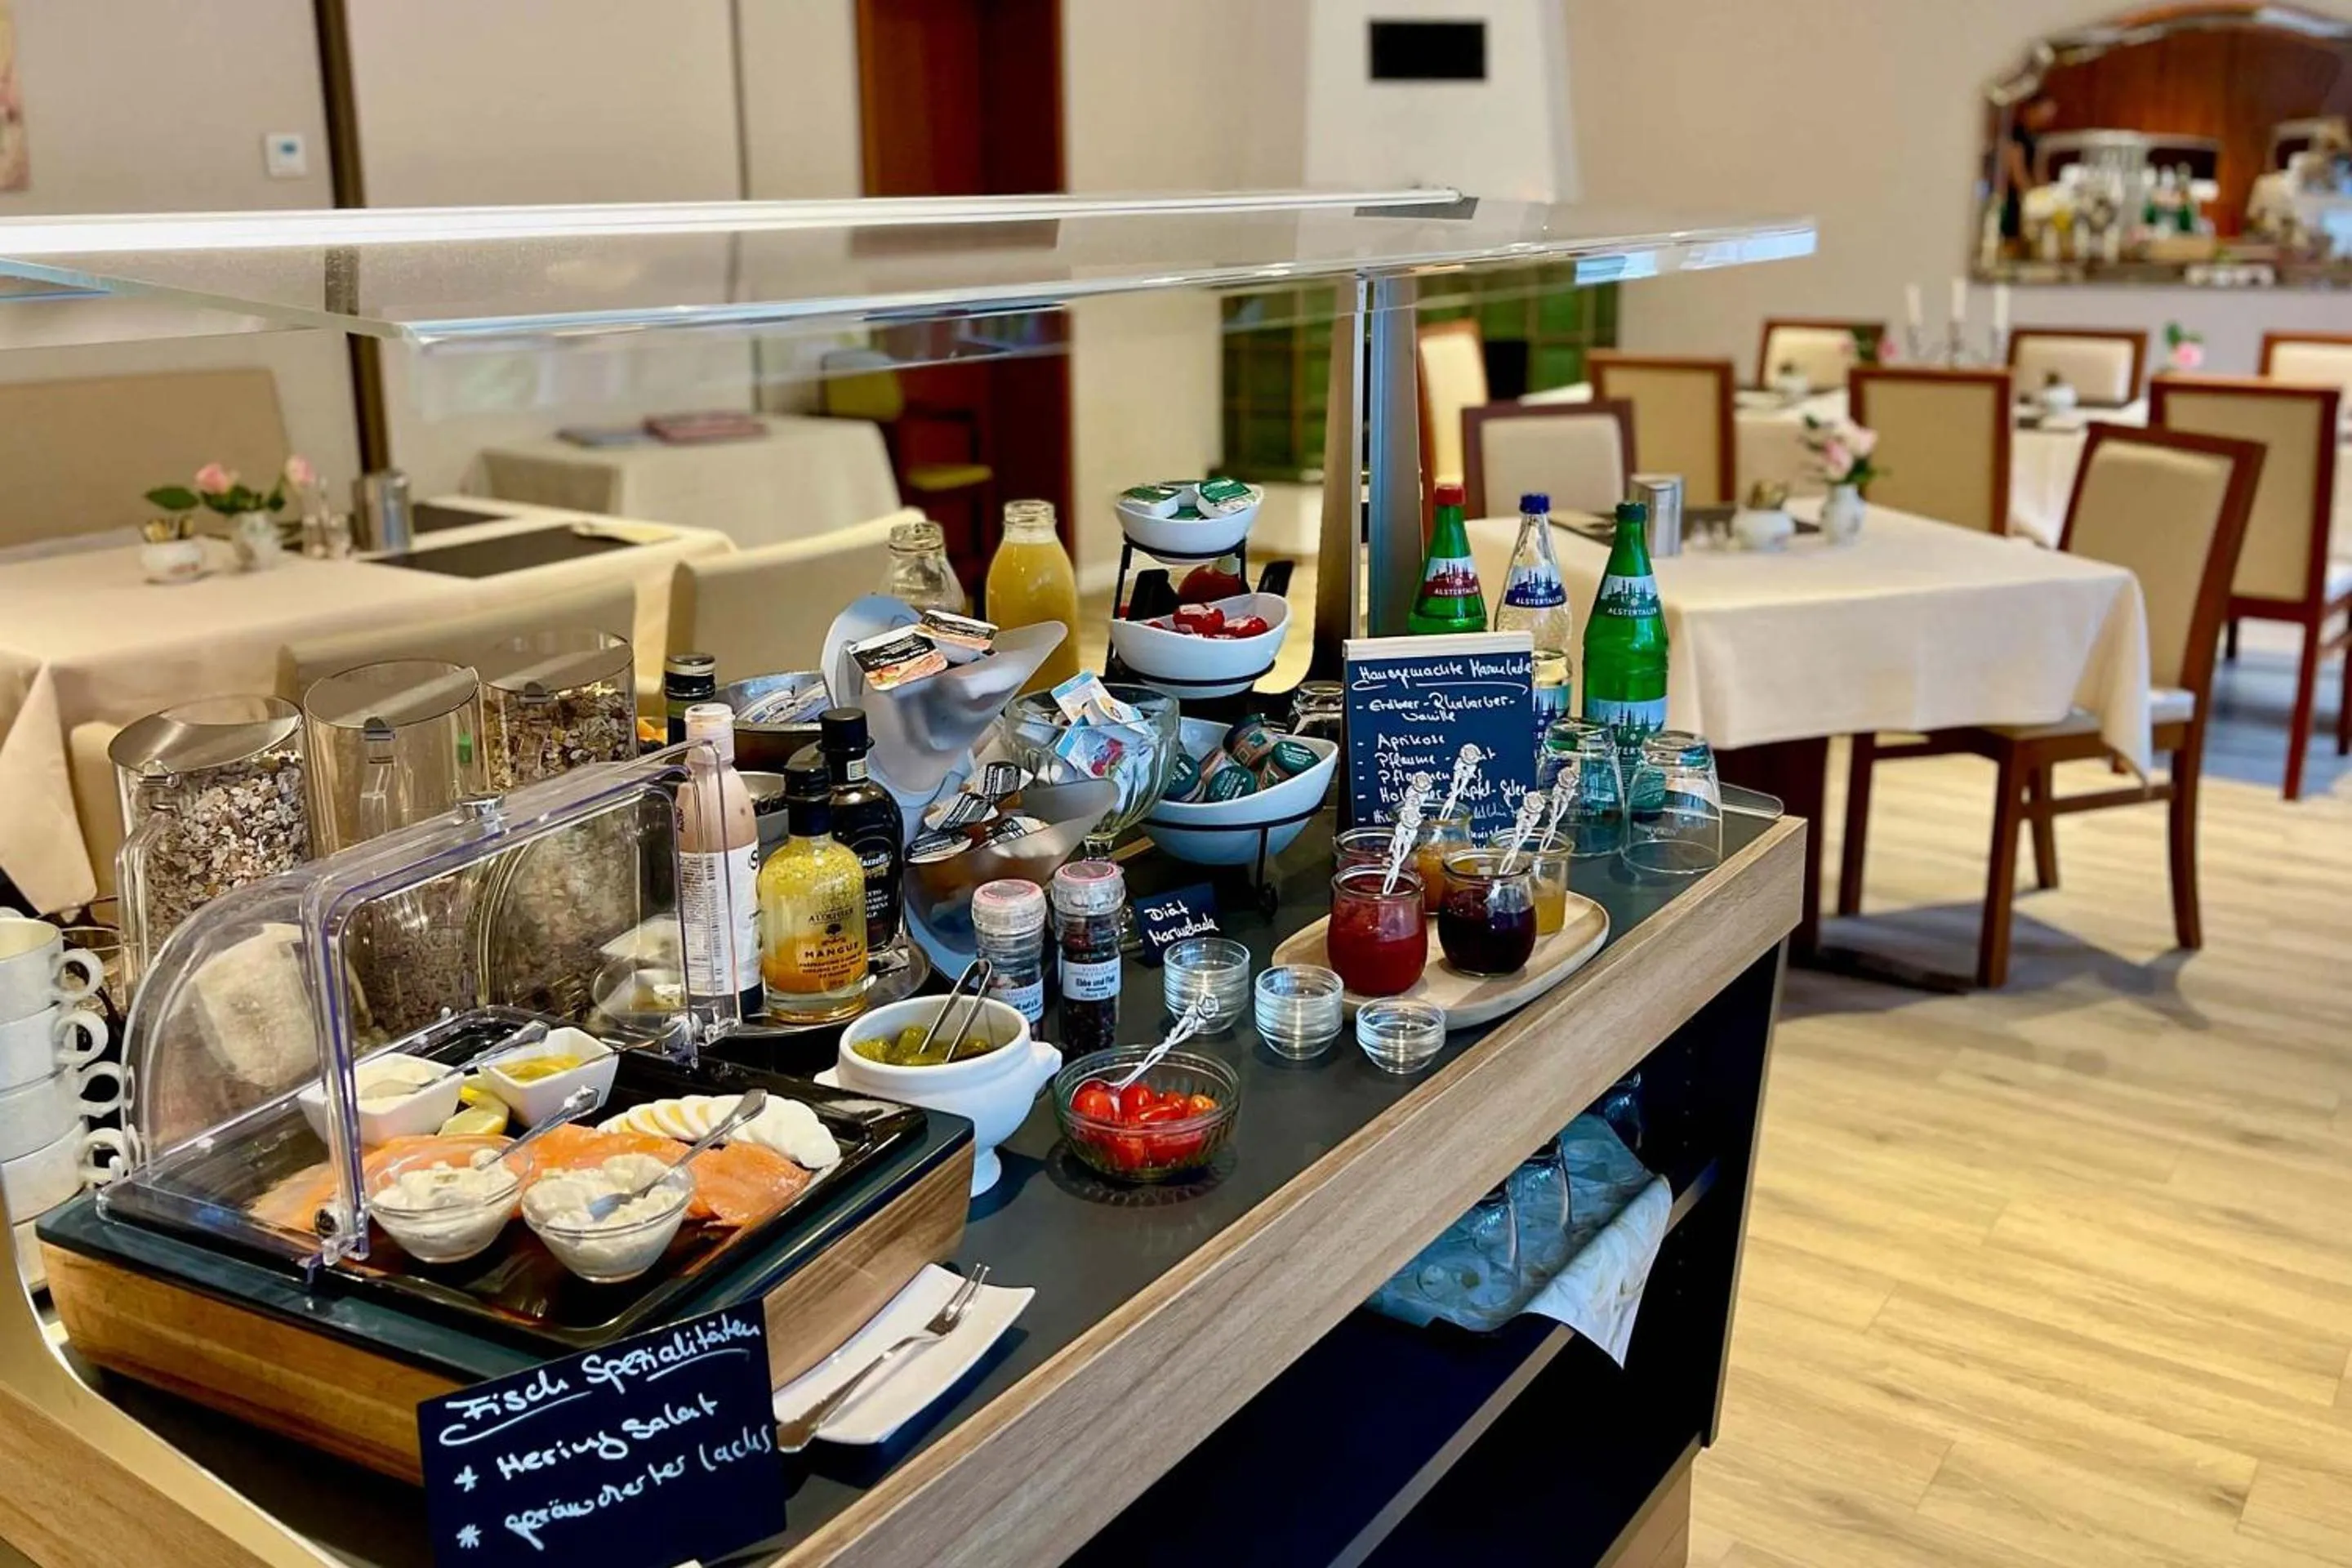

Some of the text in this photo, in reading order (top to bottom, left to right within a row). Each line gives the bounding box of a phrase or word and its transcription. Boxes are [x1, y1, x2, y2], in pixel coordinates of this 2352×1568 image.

[1359, 662, 1463, 689] Hausgemachte
[1377, 733, 1446, 751] Aprikose
[1143, 899, 1189, 922] Diät
[446, 1313, 760, 1420] Fisch Spezialitäten
[497, 1392, 718, 1480] Hering Salat
